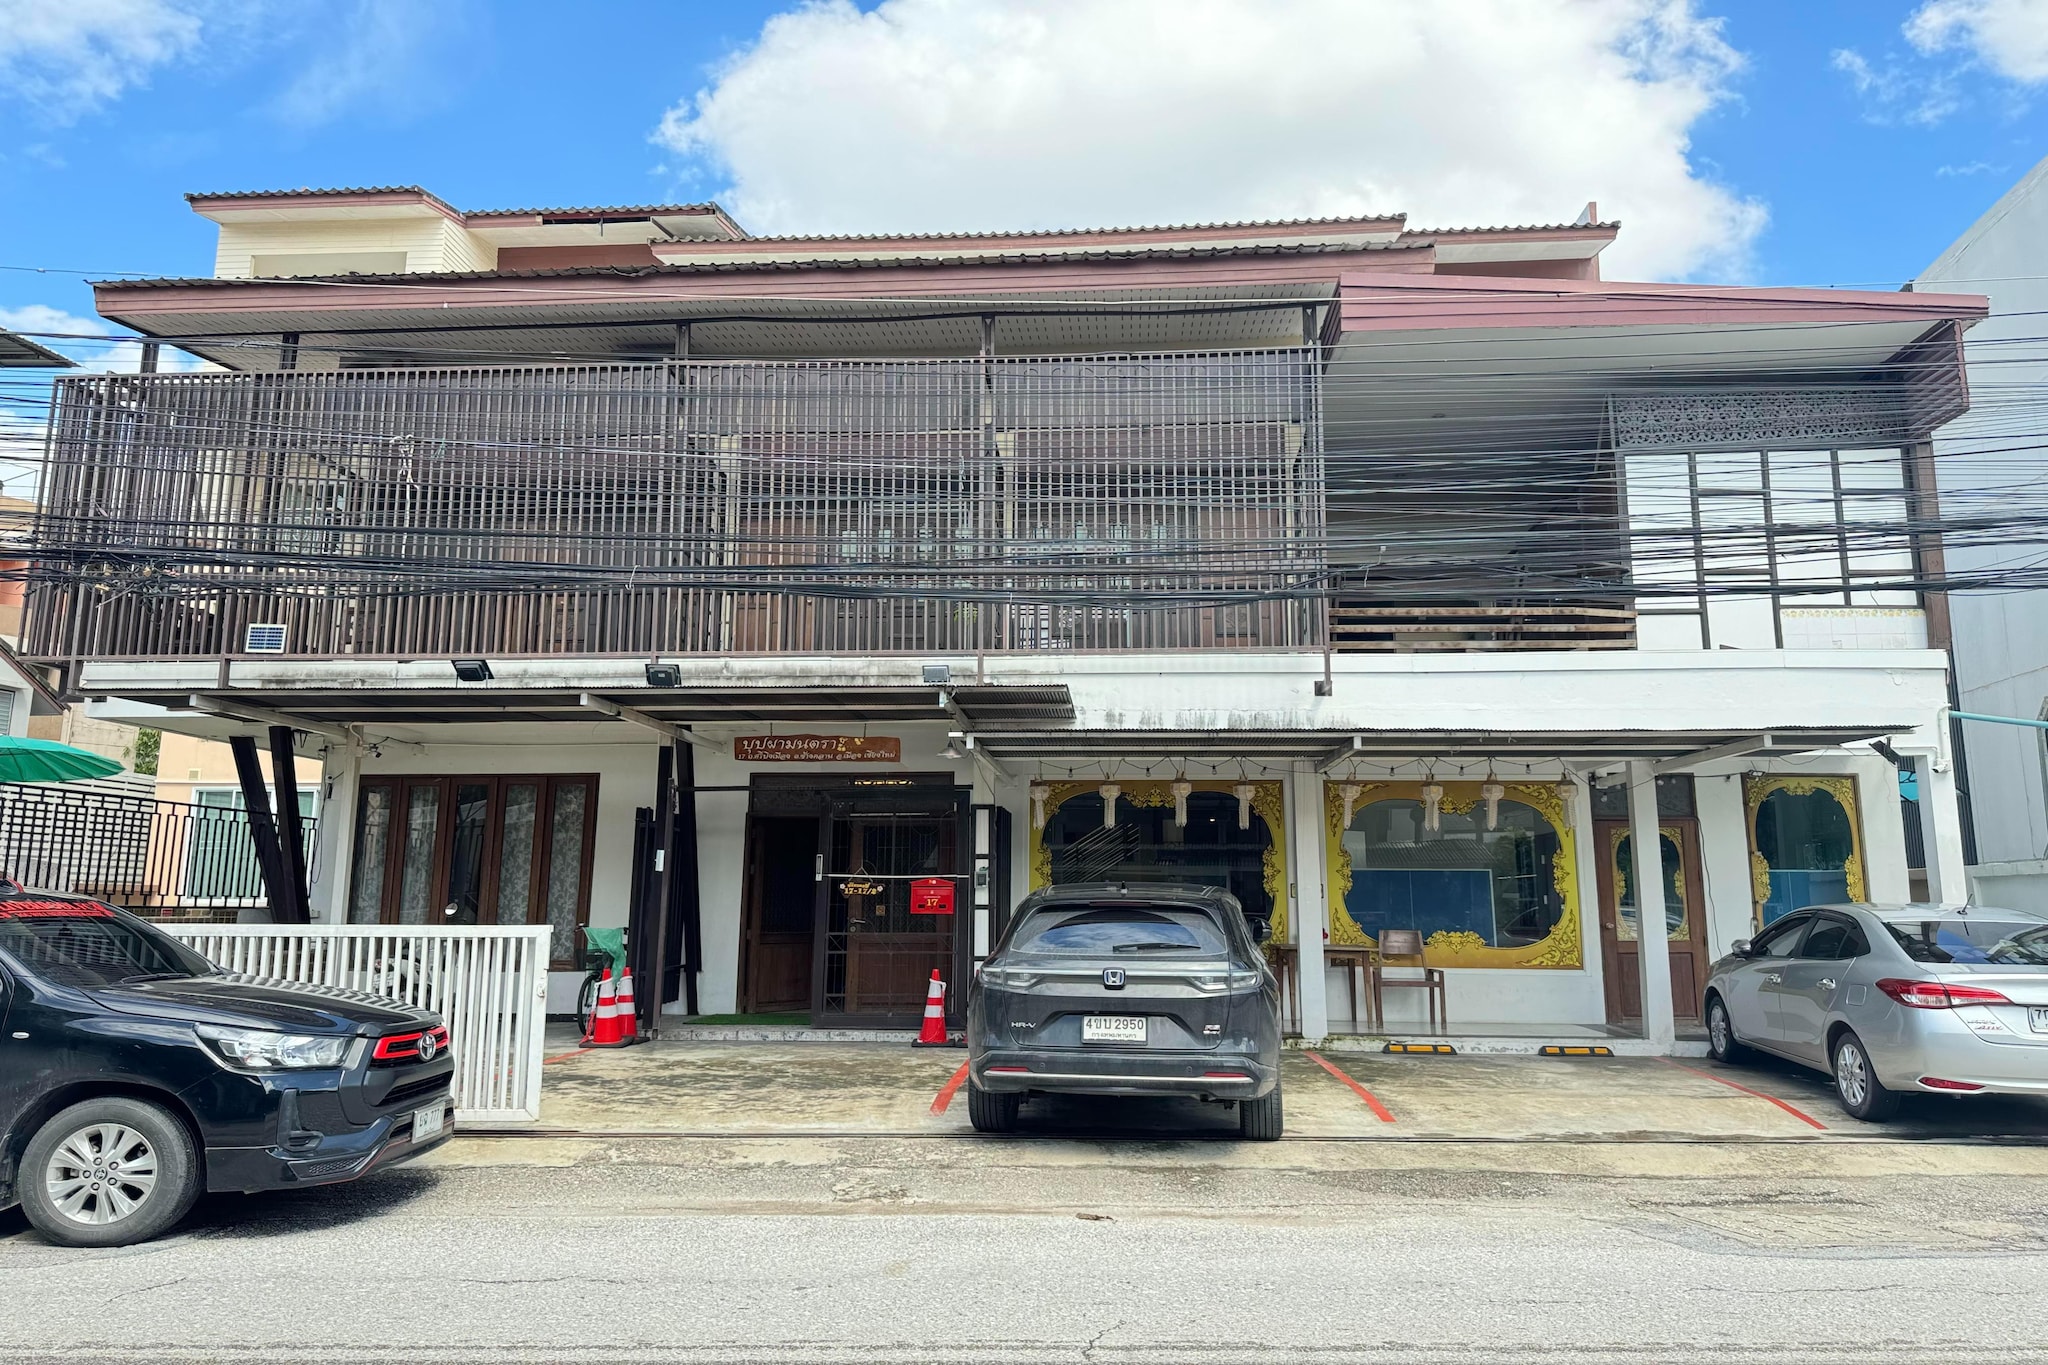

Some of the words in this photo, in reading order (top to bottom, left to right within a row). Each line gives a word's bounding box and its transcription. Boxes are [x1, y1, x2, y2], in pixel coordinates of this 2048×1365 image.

[926, 898, 938, 907] 17
[1011, 1021, 1037, 1029] HR-V
[1115, 1018, 1144, 1030] 2950
